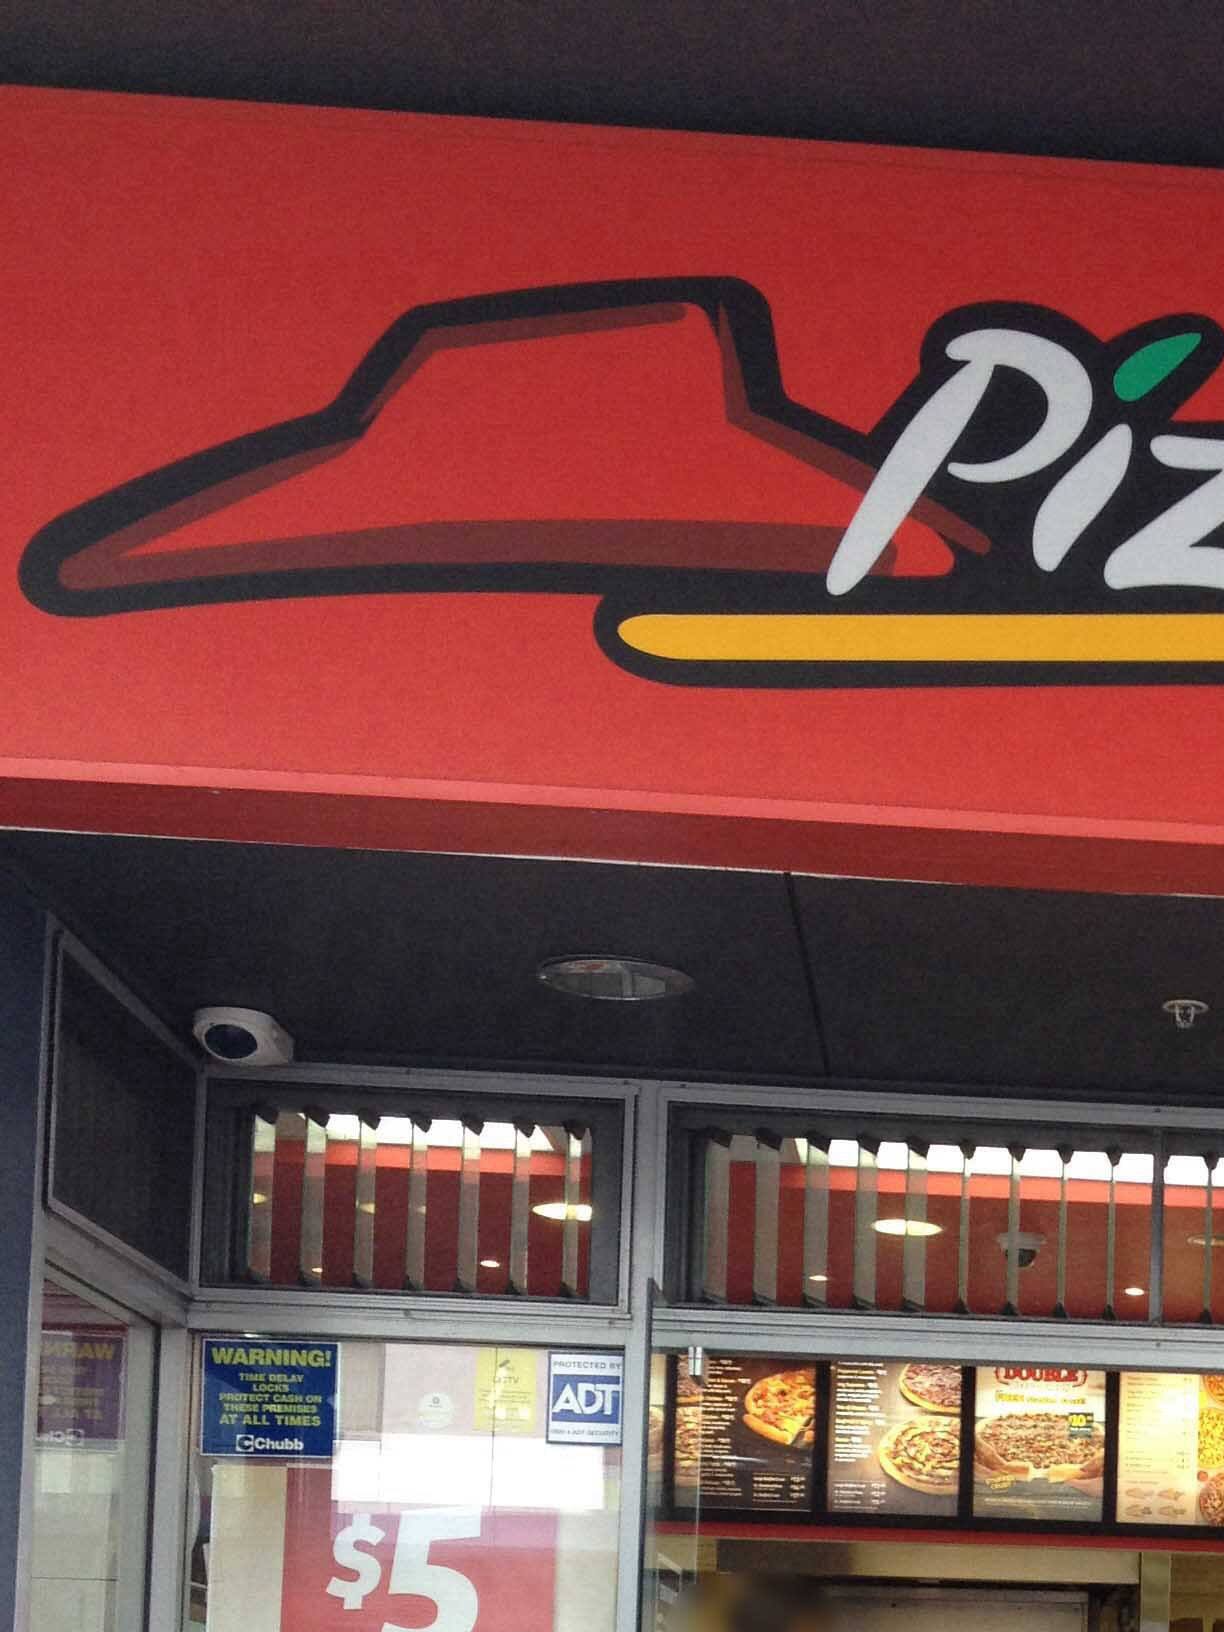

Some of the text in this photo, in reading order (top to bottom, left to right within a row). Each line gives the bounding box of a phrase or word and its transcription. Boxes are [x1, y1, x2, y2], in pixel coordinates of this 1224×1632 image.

[211, 1347, 332, 1368] WARNING!
[552, 1360, 606, 1369] PROTECTED
[239, 1372, 305, 1383] TIME DELAY
[252, 1383, 290, 1393] LOCKS
[219, 1392, 270, 1402] PROTECT
[273, 1394, 303, 1403] CASH
[551, 1382, 621, 1416] ADT
[223, 1402, 318, 1414] THESE PREMISES
[219, 1413, 321, 1427] AT ALL TIMES
[254, 1437, 304, 1451] Chubb
